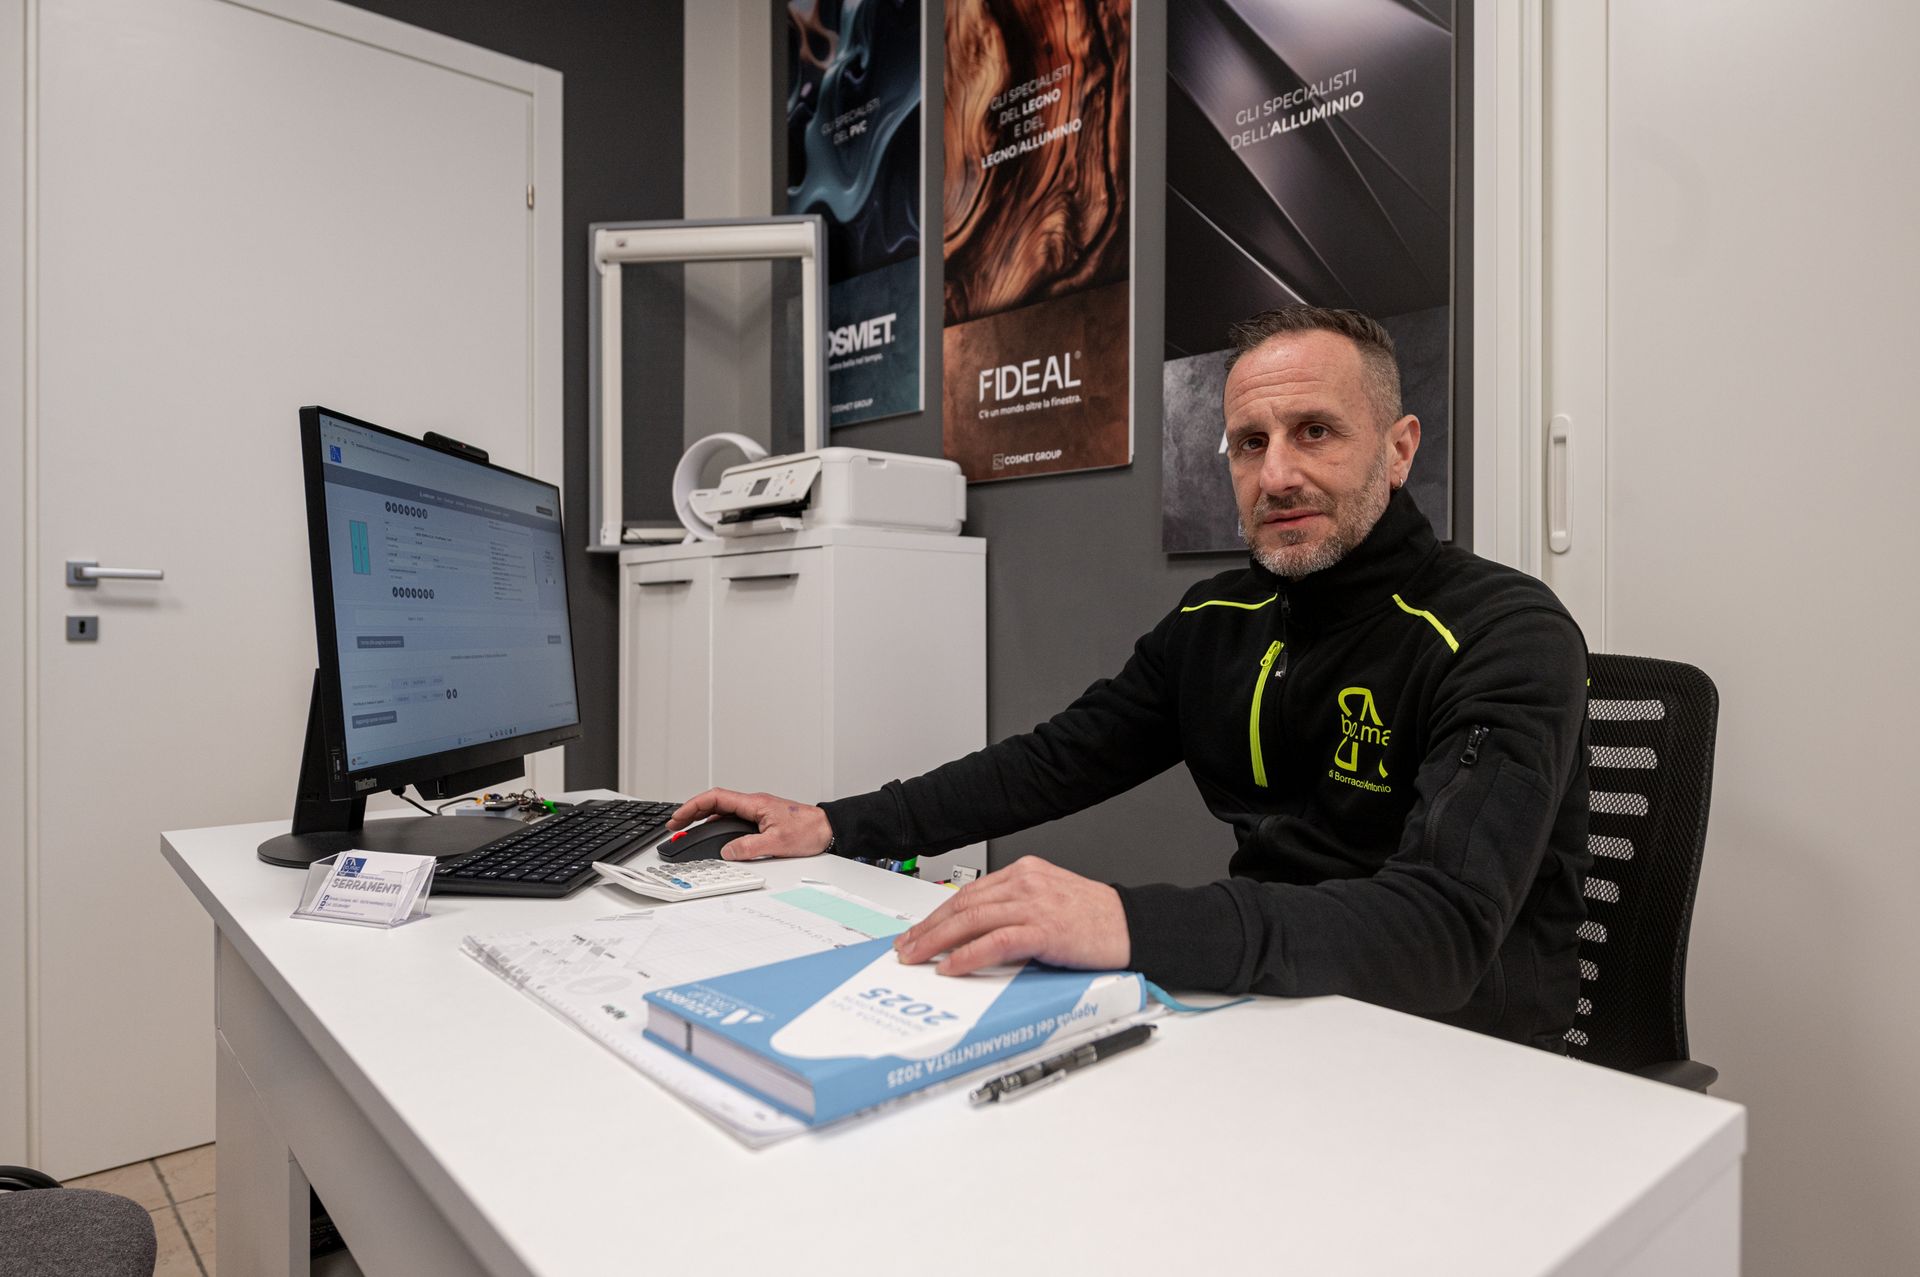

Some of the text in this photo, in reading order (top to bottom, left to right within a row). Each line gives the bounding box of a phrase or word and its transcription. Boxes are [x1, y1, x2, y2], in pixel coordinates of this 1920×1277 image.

[989, 63, 1072, 112] GLI SPECIALISTI
[1000, 88, 1062, 125] DEL LEGNO
[1235, 68, 1357, 126] GLI SPECIALISTI
[849, 119, 868, 138] PVC
[1014, 115, 1045, 138] E DEL
[1230, 90, 1364, 150] DELL'ALLUMINIO
[979, 351, 1082, 403] FIDEAL
[989, 409, 1000, 418] un
[1000, 403, 1025, 416] mondo
[1025, 400, 1042, 412] oltre
[1042, 398, 1050, 408] la
[1004, 448, 1063, 466] COSMET GROUP
[331, 878, 403, 896] SERRAMENTI
[858, 986, 960, 1027] 2025
[887, 1003, 1098, 1089] Agenda del SERRAMENTISTA 2025
